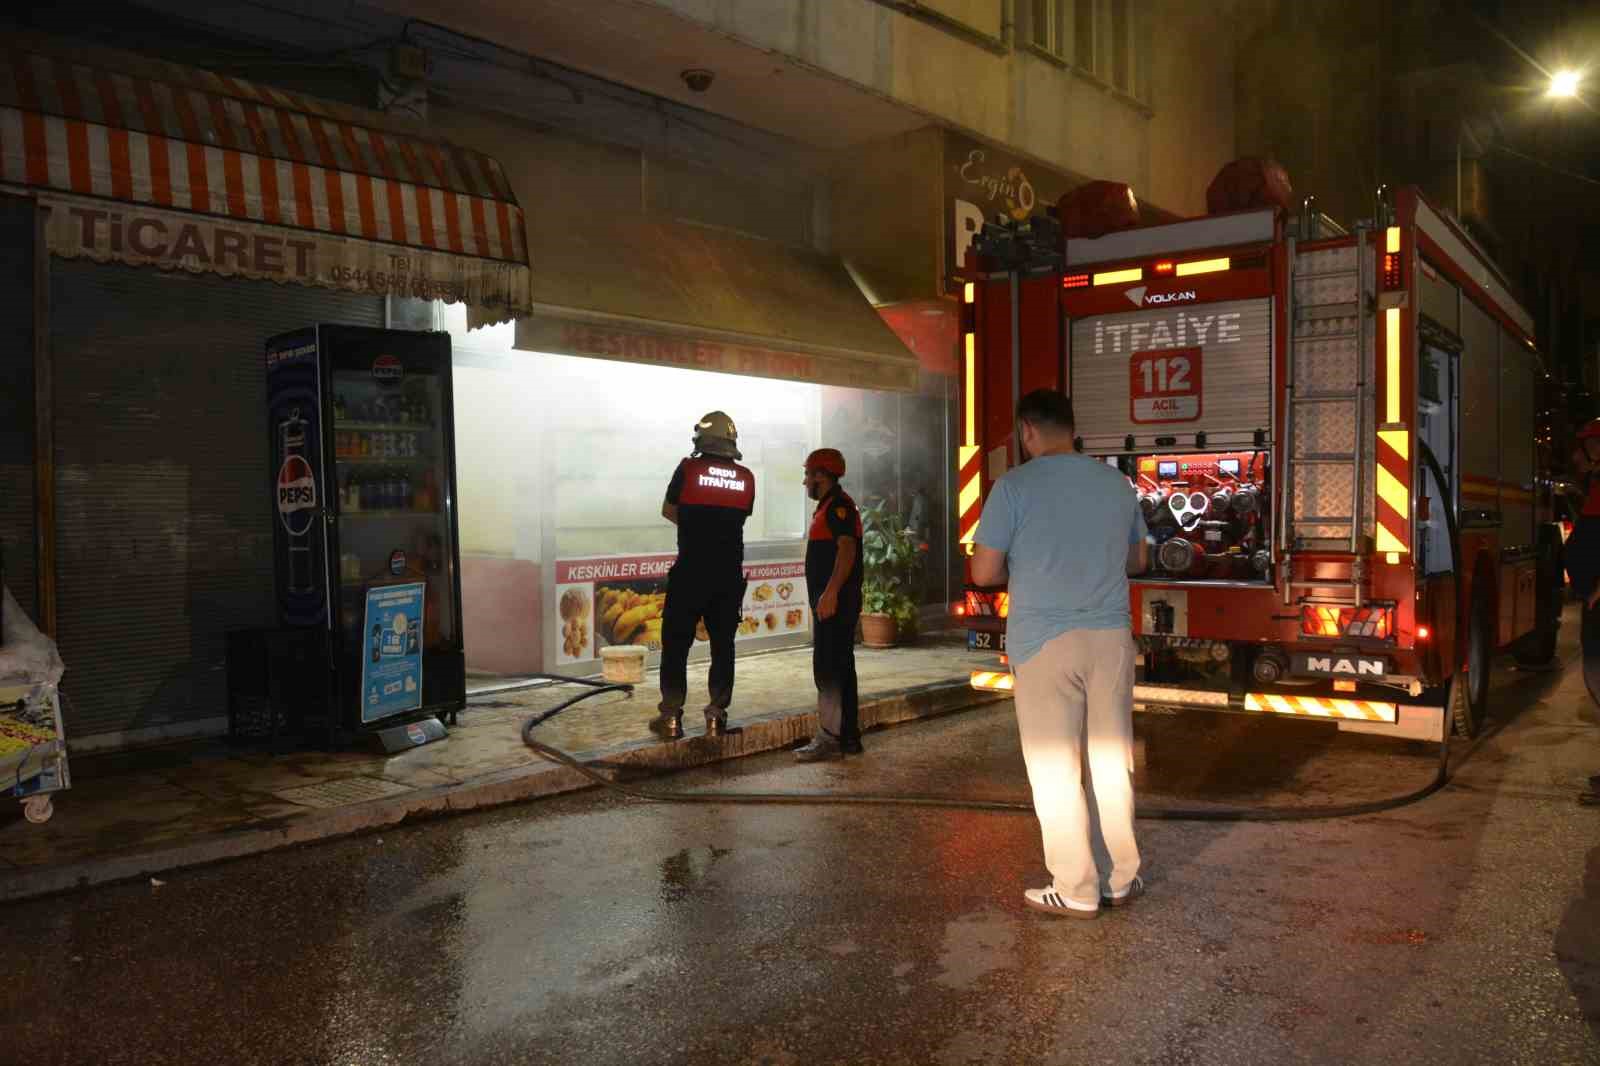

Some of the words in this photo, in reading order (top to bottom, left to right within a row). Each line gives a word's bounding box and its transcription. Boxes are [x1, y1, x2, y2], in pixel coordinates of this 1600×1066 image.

[1144, 290, 1196, 304] VOLKAN
[1095, 311, 1241, 354] İTFAİYE
[1139, 356, 1191, 393] 112
[708, 466, 737, 479] ORDU
[279, 486, 314, 505] PEPSI
[567, 560, 637, 580] KESKİNLER
[639, 560, 676, 576] EKME
[976, 632, 991, 648] 52
[1307, 656, 1384, 676] MAN
